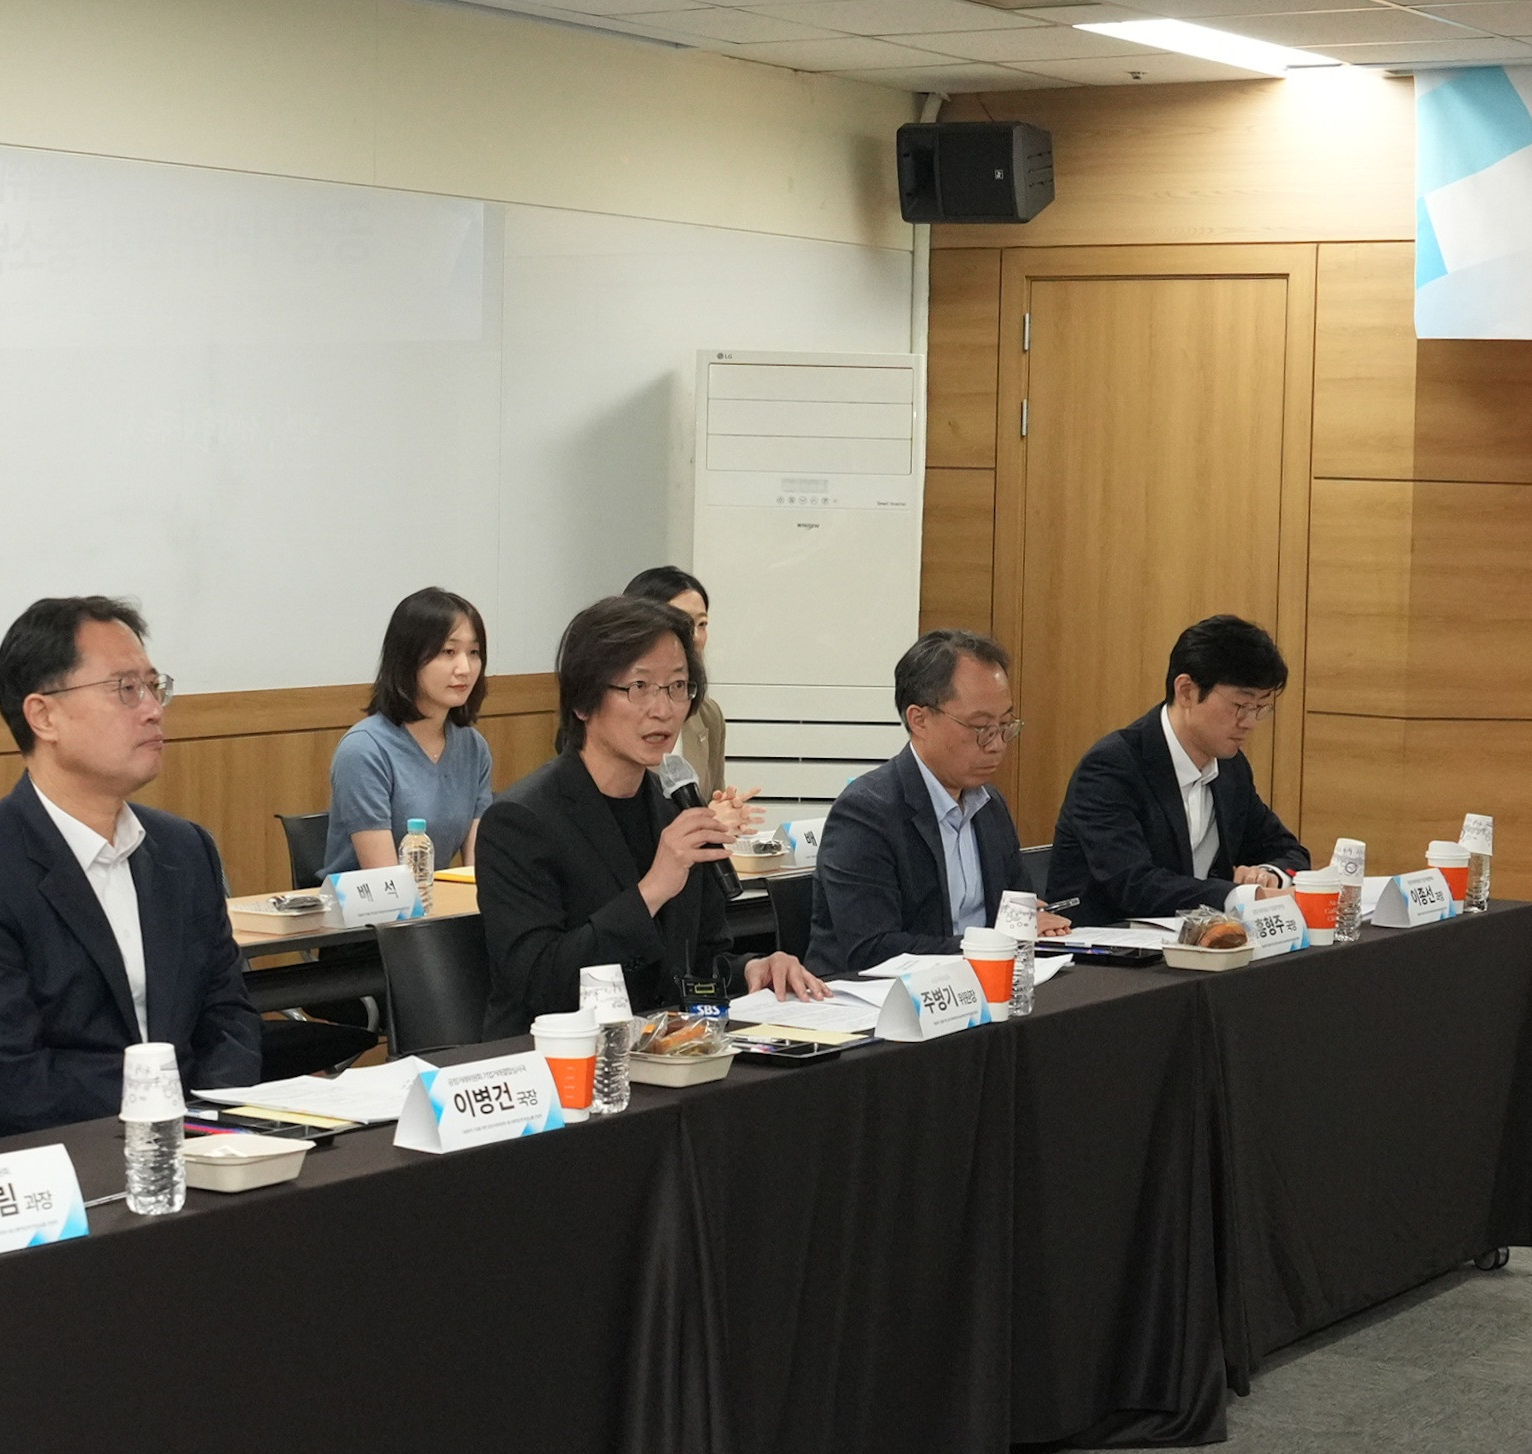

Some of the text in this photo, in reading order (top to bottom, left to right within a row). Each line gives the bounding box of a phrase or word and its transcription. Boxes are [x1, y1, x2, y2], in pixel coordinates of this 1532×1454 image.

[696, 1004, 721, 1016] SBS
[920, 985, 959, 1014] 주병기
[453, 1081, 539, 1118] 이병건 국장
[23, 1189, 54, 1212] 과장
